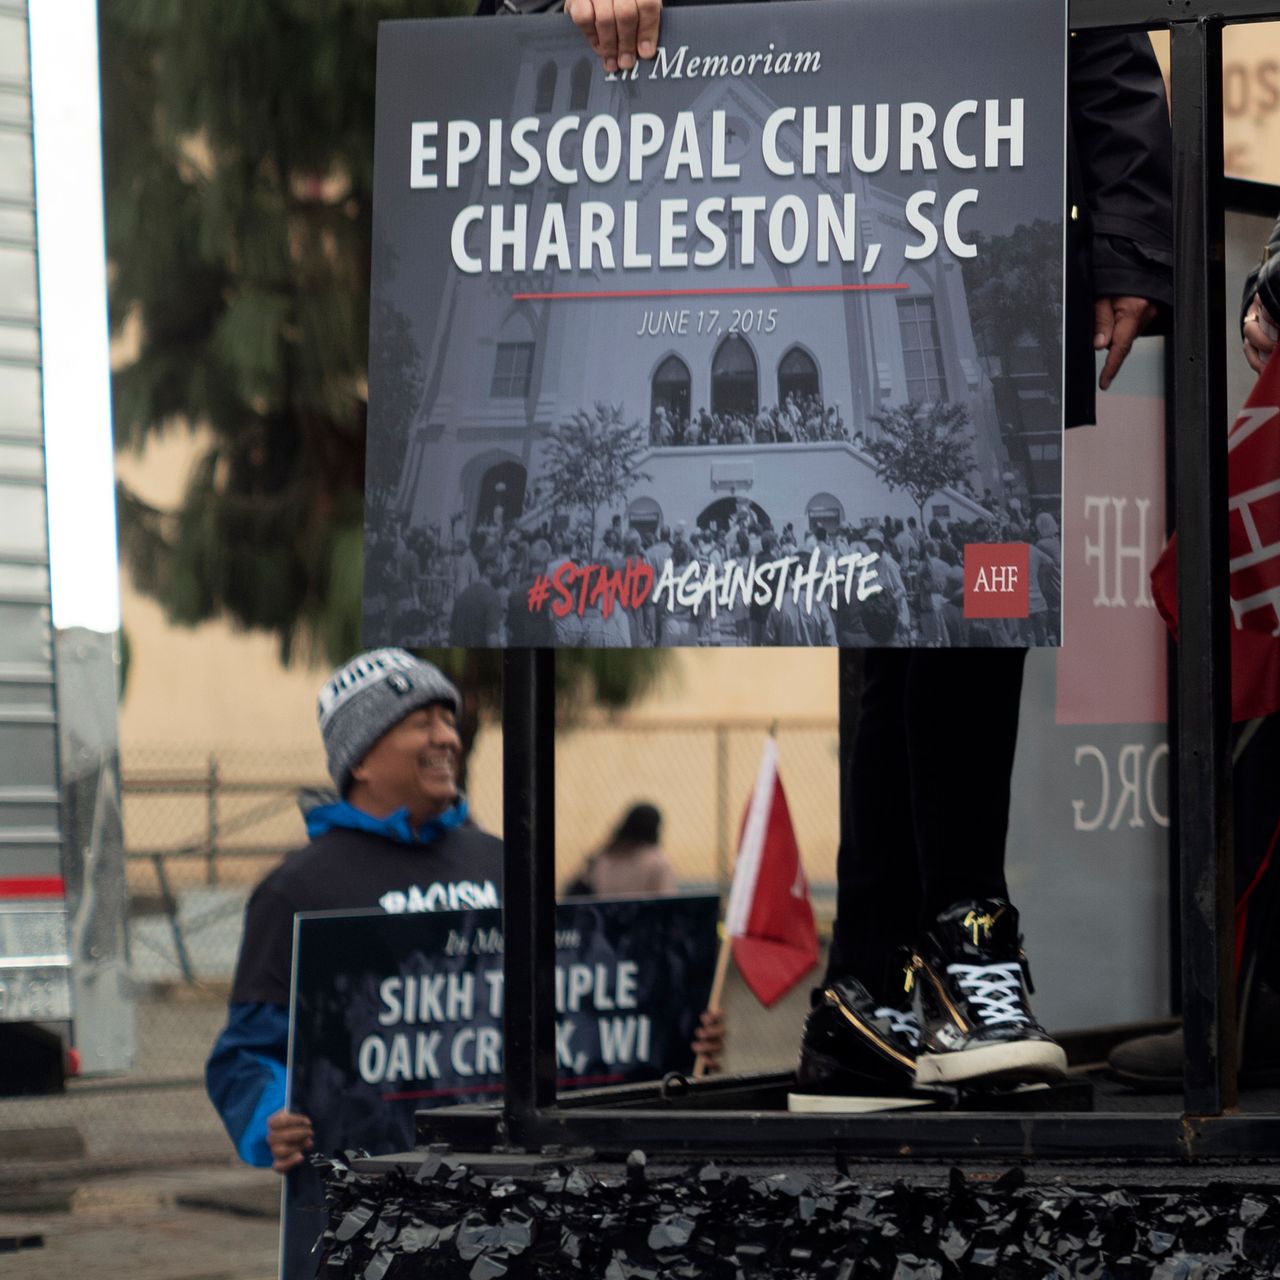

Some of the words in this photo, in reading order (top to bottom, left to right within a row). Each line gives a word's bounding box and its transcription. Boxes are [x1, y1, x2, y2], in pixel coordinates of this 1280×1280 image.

[648, 42, 822, 80] Memoriam
[410, 110, 741, 188] EPISCOPAL
[761, 98, 1025, 176] CHURCH
[450, 192, 882, 273] CHARLESTON,
[904, 188, 980, 259] SC
[637, 310, 690, 336] JUNE
[698, 310, 722, 336] 17,
[729, 308, 778, 334] 2015
[973, 565, 1019, 593] AHF
[379, 972, 474, 1026] SIKH
[486, 960, 639, 1020] TPLE
[358, 1031, 443, 1084] OAK
[451, 1022, 590, 1076] CRK,
[598, 1014, 651, 1064] WI
